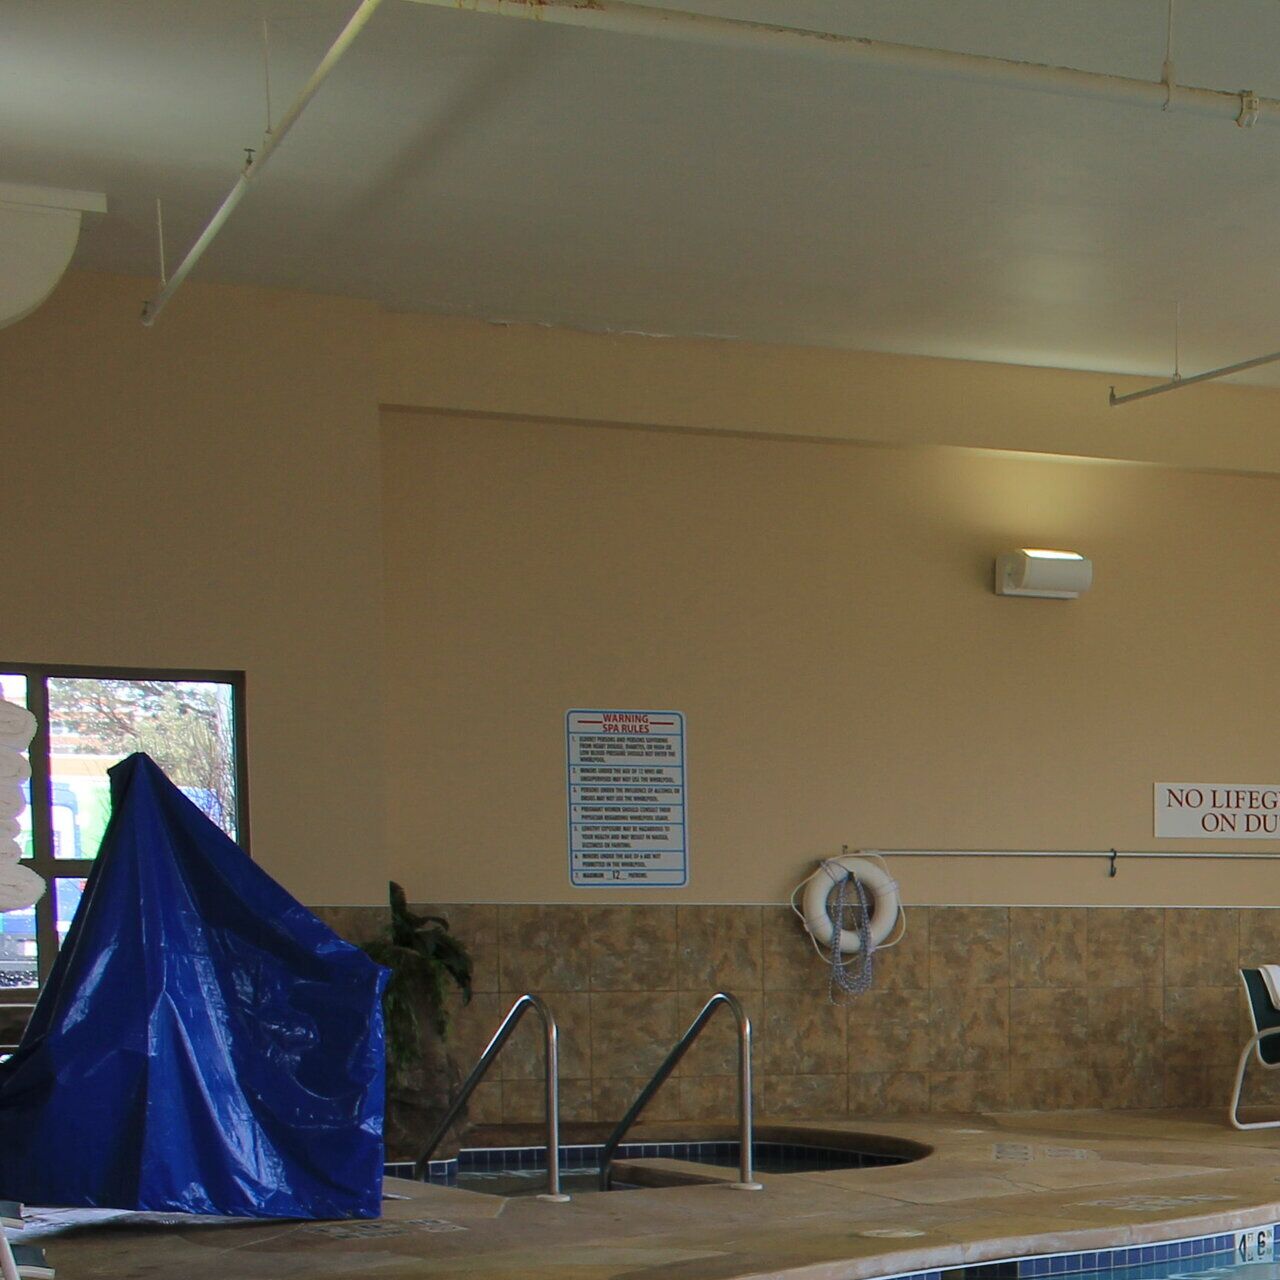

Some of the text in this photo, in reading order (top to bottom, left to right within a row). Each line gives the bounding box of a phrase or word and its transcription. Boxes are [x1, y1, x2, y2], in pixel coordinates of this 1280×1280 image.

[602, 714, 649, 723] WARNING
[602, 724, 650, 733] SPA RULES
[1166, 788, 1203, 808] NO
[1201, 813, 1236, 833] ON
